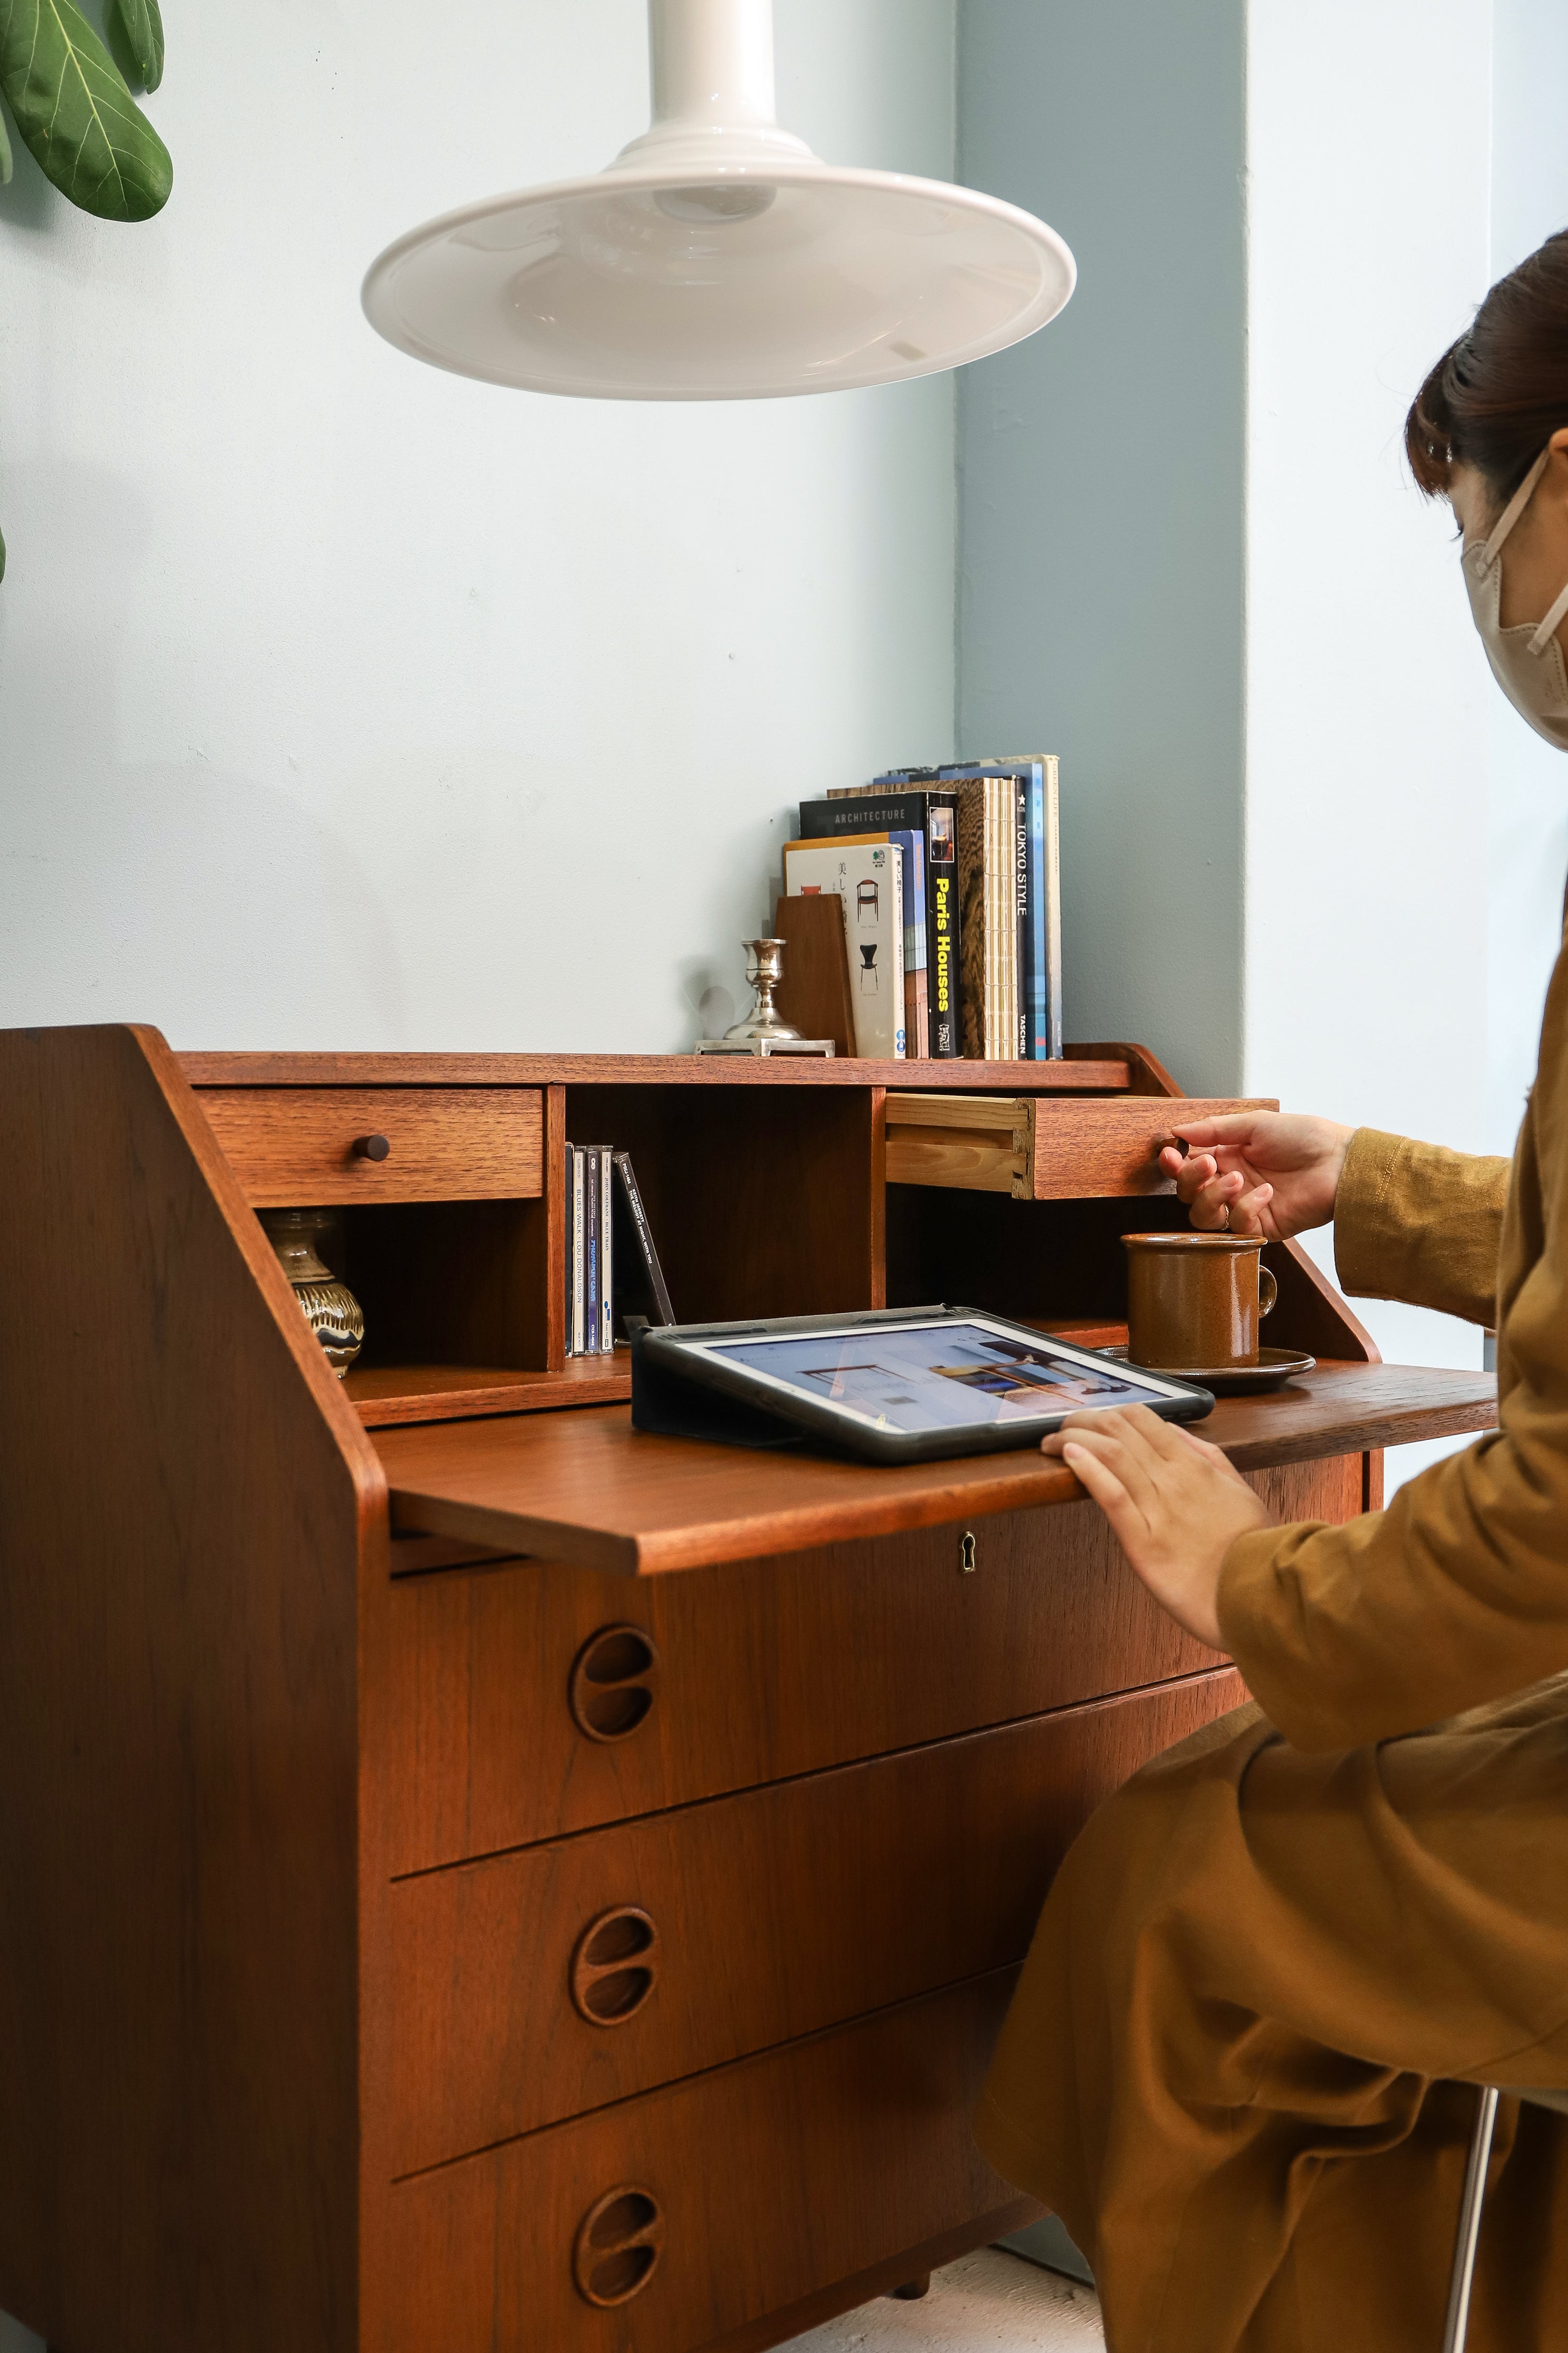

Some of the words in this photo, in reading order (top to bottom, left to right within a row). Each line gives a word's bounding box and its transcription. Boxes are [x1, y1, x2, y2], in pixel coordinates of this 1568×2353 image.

[835, 809, 905, 824] ARCHITECTURE
[1017, 823, 1026, 869] TOKYO
[936, 878, 950, 931] Paris
[1018, 873, 1027, 916] STYLE
[937, 936, 950, 1012] Houses
[622, 1163, 631, 1184] POCJ-1464
[632, 1200, 640, 1219] MELODY
[636, 1203, 644, 1222] JARRETT
